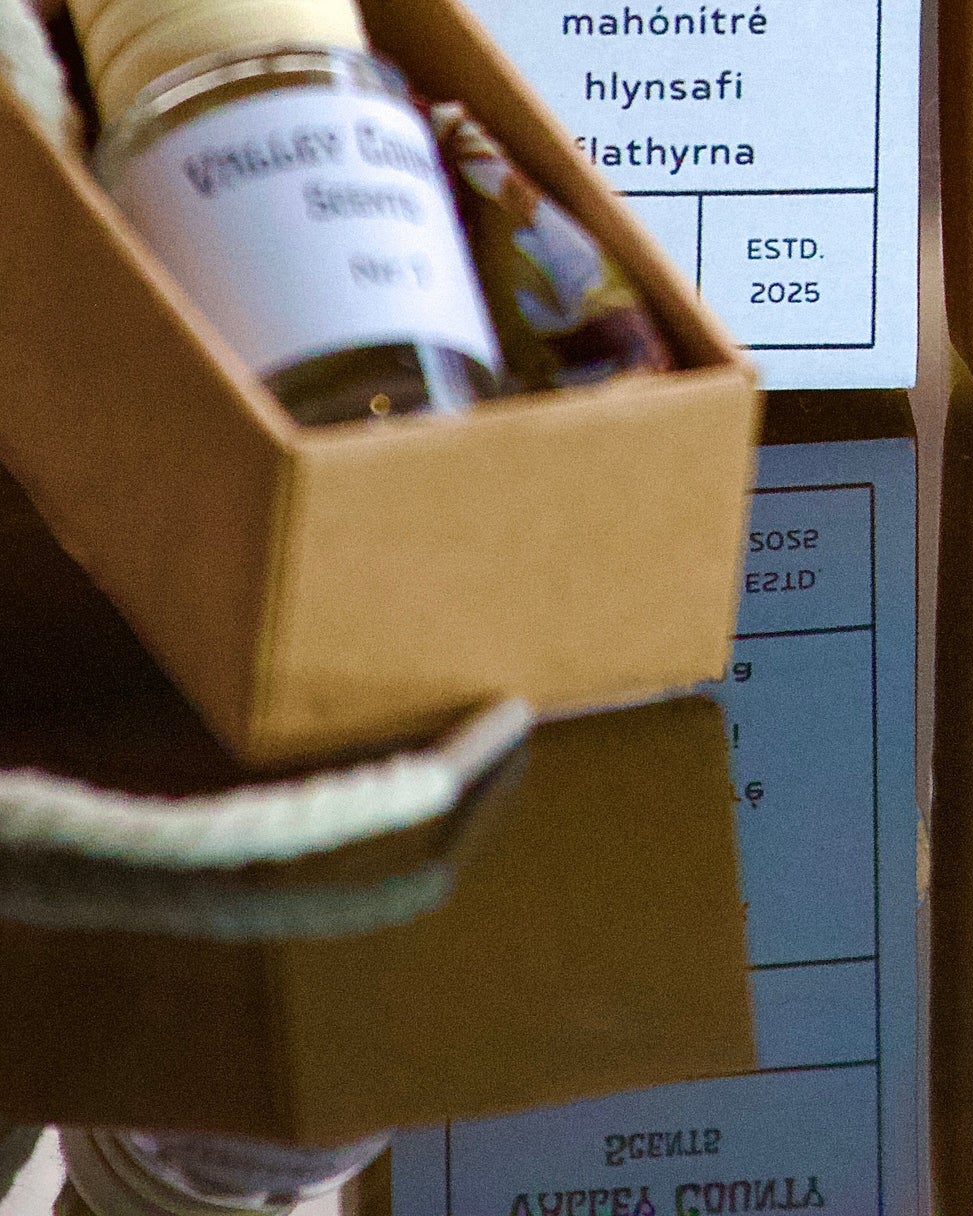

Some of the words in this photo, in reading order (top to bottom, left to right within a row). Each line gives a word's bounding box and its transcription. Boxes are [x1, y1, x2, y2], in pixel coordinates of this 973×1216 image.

[585, 69, 742, 110] hlynsafi
[747, 237, 826, 261] ESTD.
[750, 281, 821, 304] 2025
